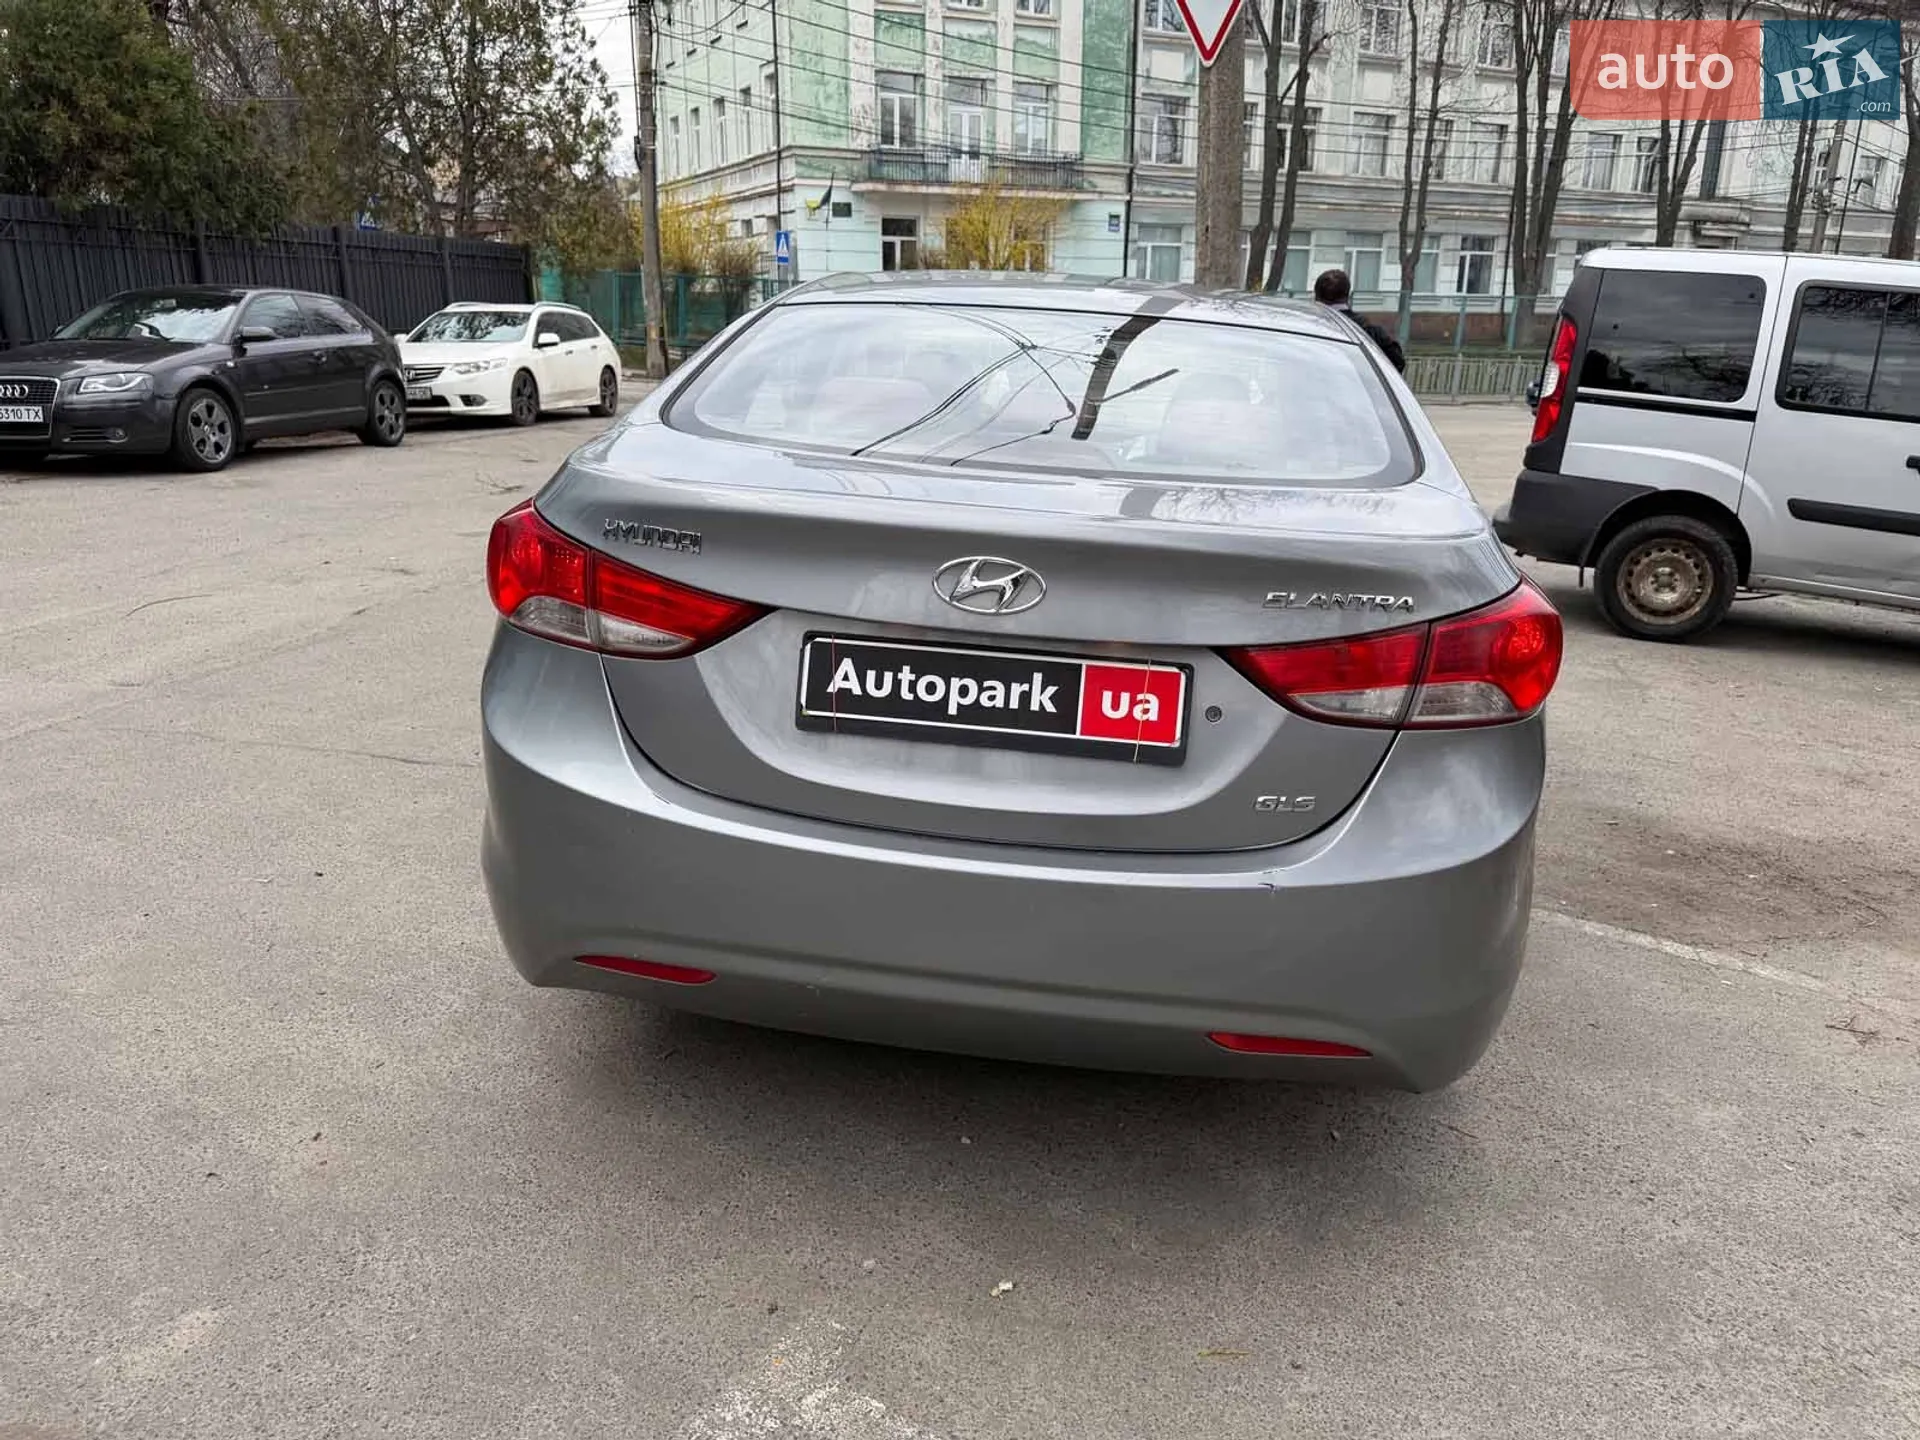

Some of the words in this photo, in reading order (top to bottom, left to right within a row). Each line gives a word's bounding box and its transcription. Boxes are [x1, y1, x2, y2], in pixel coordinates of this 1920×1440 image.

[24, 407, 41, 420] TX
[603, 518, 702, 554] HYUNDAI
[1262, 591, 1415, 613] ELANTRA
[826, 657, 1060, 716] Autopark
[1101, 689, 1161, 722] ua
[1254, 795, 1317, 812] GLS
